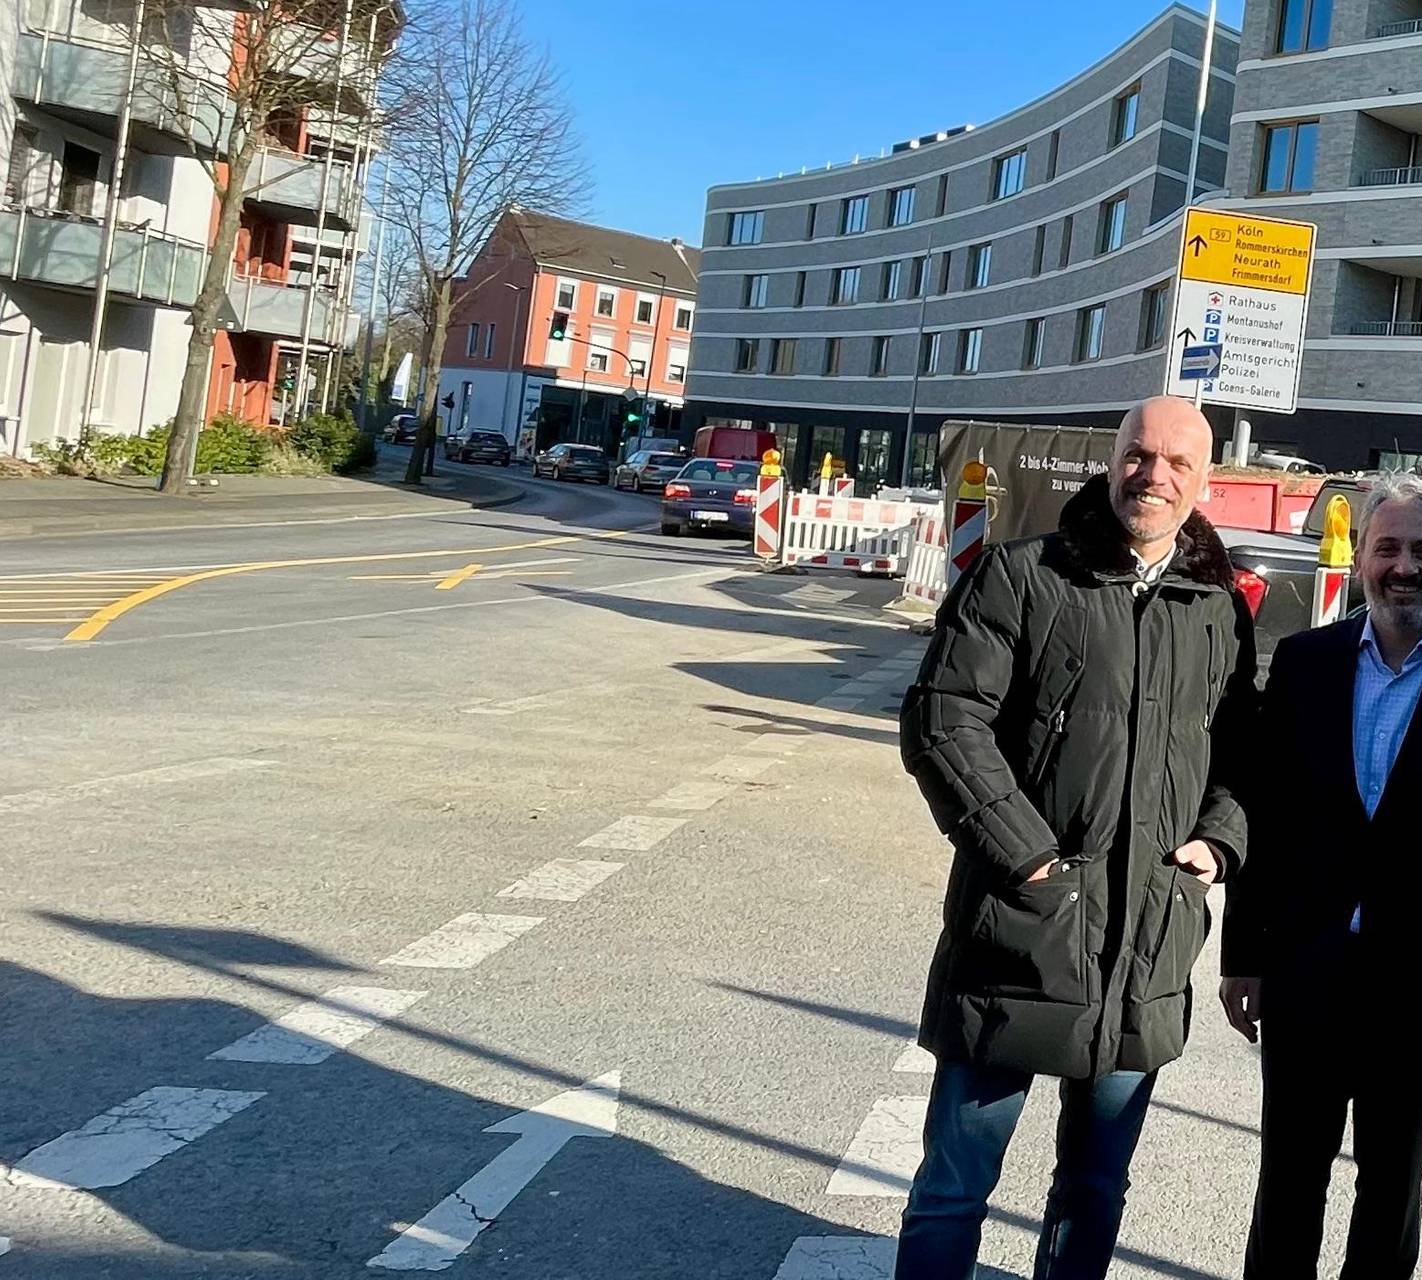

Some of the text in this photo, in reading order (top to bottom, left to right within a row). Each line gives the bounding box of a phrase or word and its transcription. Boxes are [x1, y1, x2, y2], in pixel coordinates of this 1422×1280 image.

[1215, 230, 1226, 239] 59
[1237, 224, 1264, 237] Köln
[1235, 239, 1308, 257] Rommerskirchen
[1233, 253, 1281, 269] Neurath
[1232, 268, 1292, 285] Frimmersdorf
[1229, 295, 1277, 311] Rathaus
[1227, 314, 1283, 330] Montanushof
[1224, 332, 1295, 353] Kreisverwaltung
[1223, 350, 1295, 368] Amtsgericht
[1221, 364, 1260, 378] Polizei
[1219, 381, 1281, 398] Coens-Galerie
[1020, 455, 1027, 469] 2
[1028, 455, 1041, 470] bis
[1052, 479, 1063, 491] zu
[1213, 488, 1226, 498] 52
